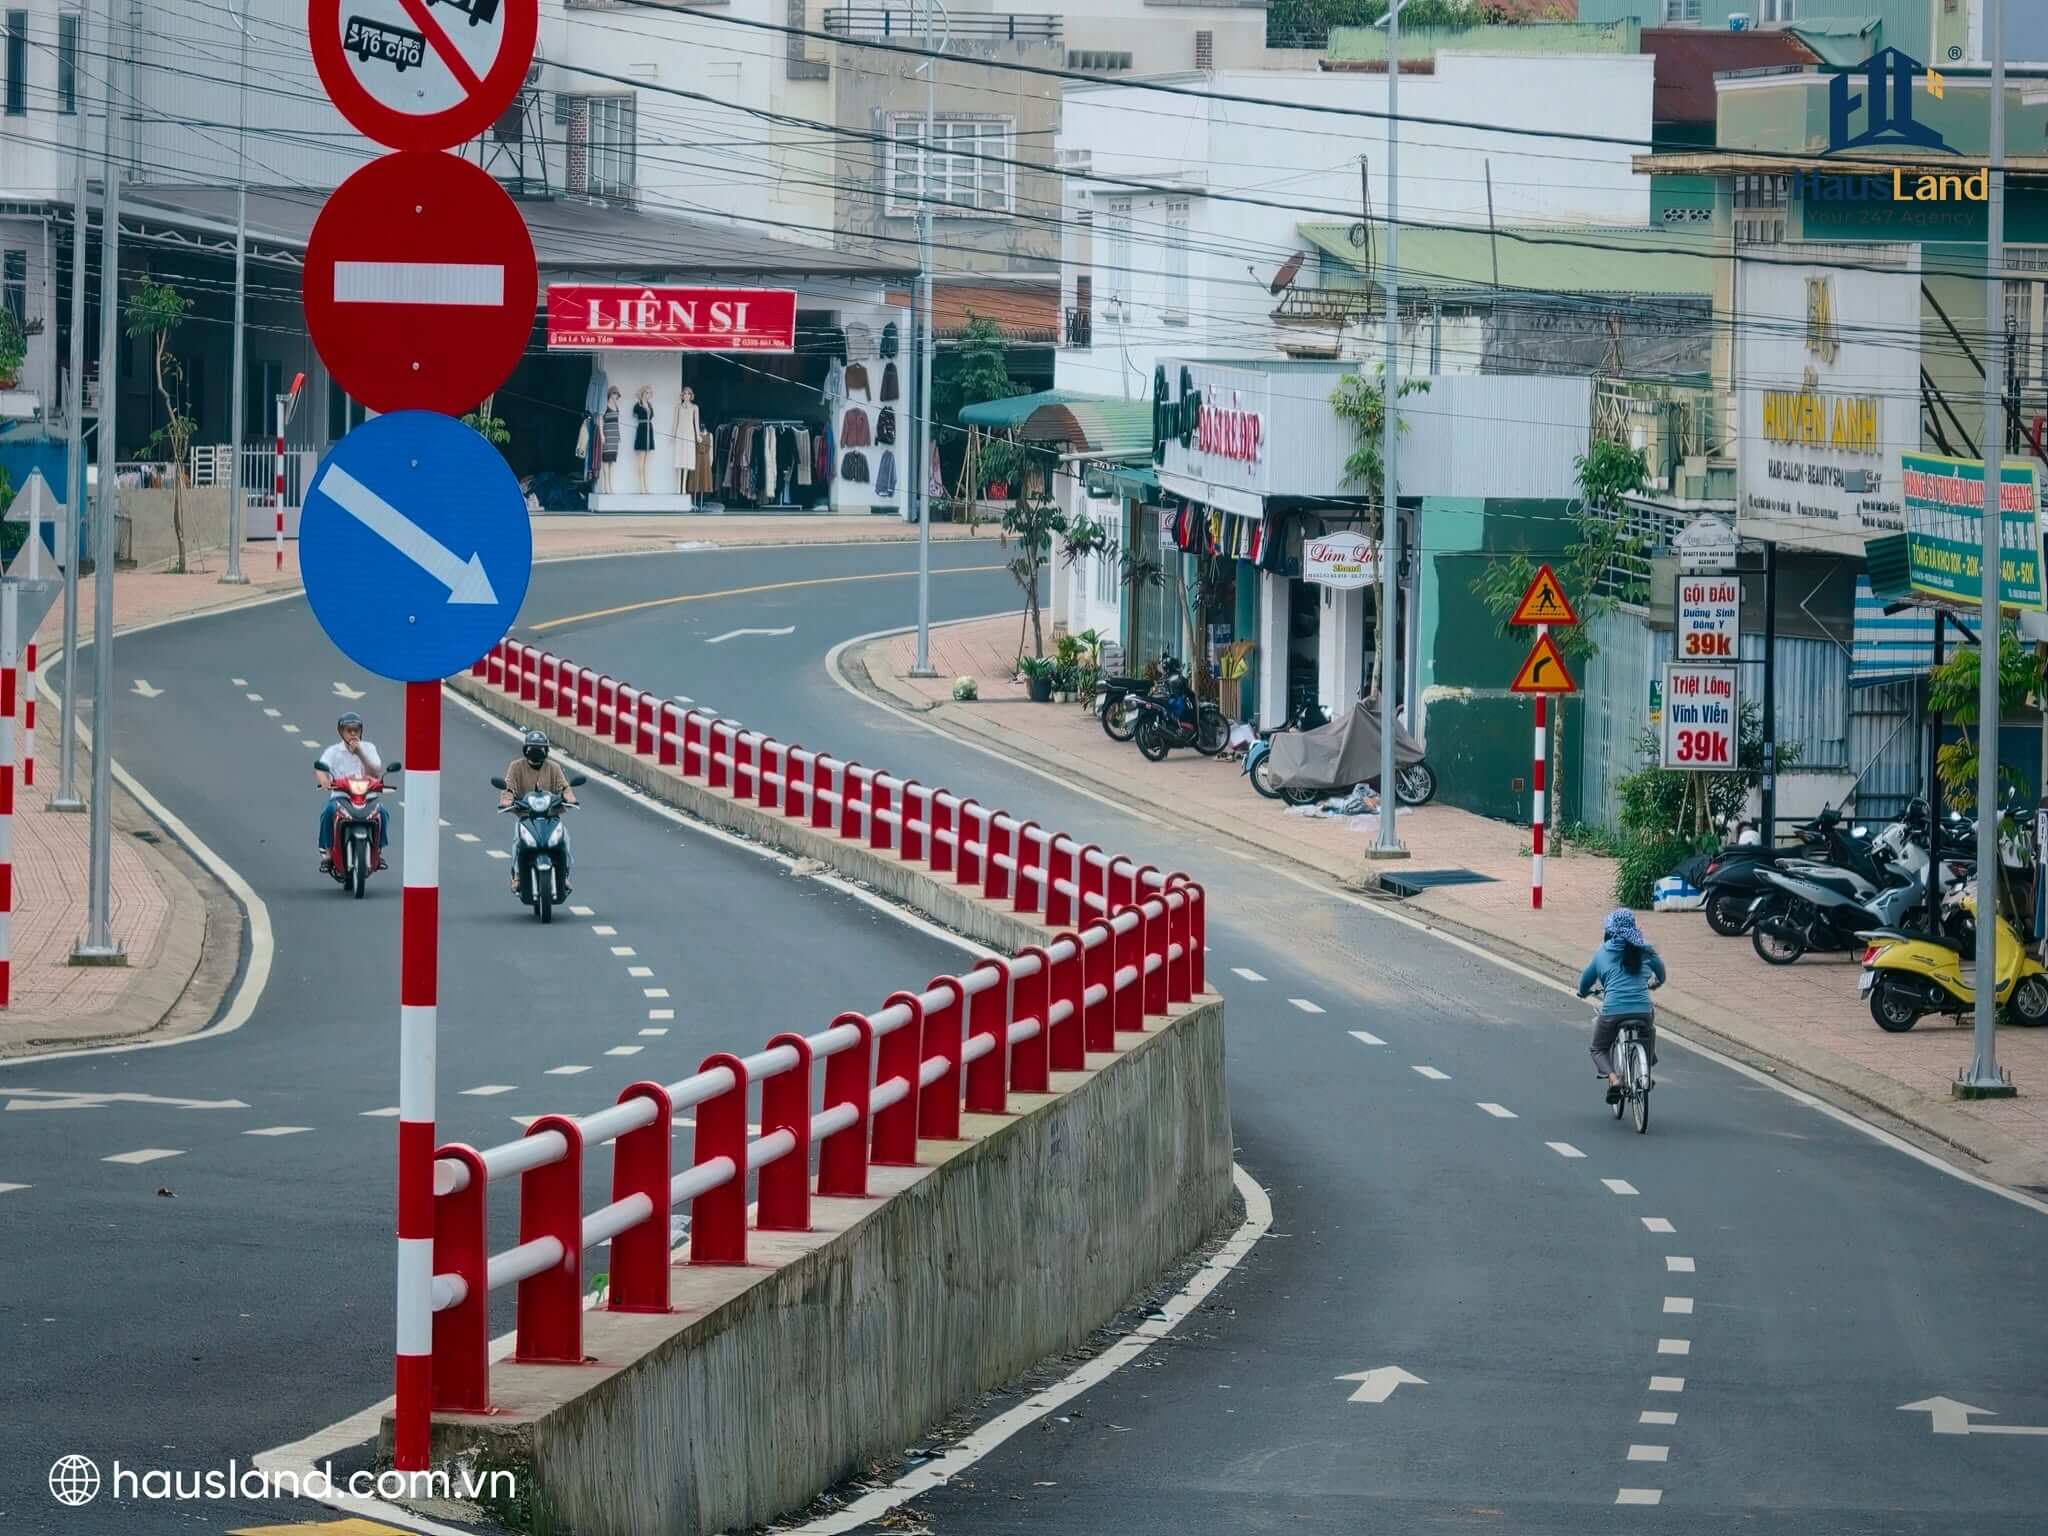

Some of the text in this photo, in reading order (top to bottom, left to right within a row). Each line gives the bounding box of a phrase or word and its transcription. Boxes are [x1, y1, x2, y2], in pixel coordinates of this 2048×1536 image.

[348, 29, 420, 63] >16 chỗ
[587, 290, 750, 333] LIÊN SI
[1832, 397, 1877, 453] ANH
[1768, 459, 1783, 479] HAIR
[1783, 462, 1804, 484] SALON
[1808, 464, 1834, 488] BEAUTY
[1834, 467, 1845, 488] SPA
[1967, 555, 1979, 577] 20K
[2002, 560, 2016, 583] 40K
[2021, 562, 2035, 584] 50K
[1683, 583, 1705, 606] GỘI
[1692, 619, 1725, 630] Đông Y
[1715, 608, 1735, 618] Sinh
[1686, 633, 1732, 656] 39k
[1673, 675, 1699, 697] Triệt
[1704, 675, 1731, 698] Lông
[1672, 702, 1728, 724] Vĩnh Viễn
[1677, 730, 1728, 762] 39k
